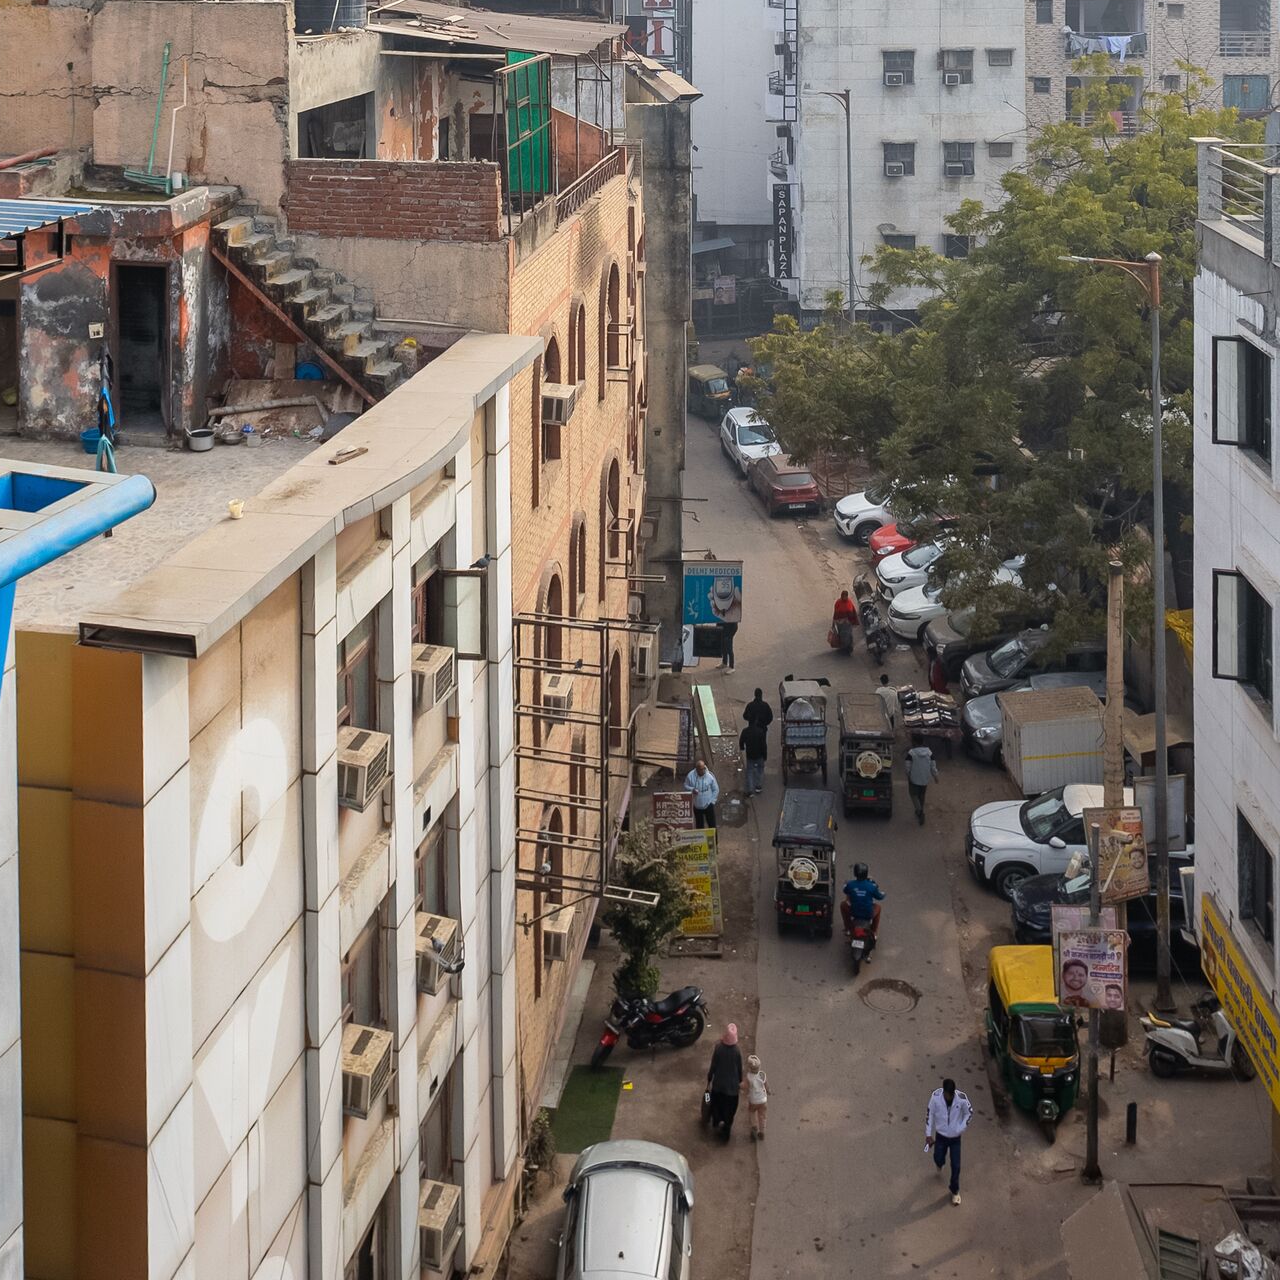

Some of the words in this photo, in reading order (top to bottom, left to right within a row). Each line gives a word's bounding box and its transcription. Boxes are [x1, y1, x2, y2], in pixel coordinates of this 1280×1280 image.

[778, 190, 787, 233] SAPAN
[779, 236, 788, 278] PLAZA
[687, 567, 707, 575] DELHI
[709, 567, 740, 575] MEDICOS
